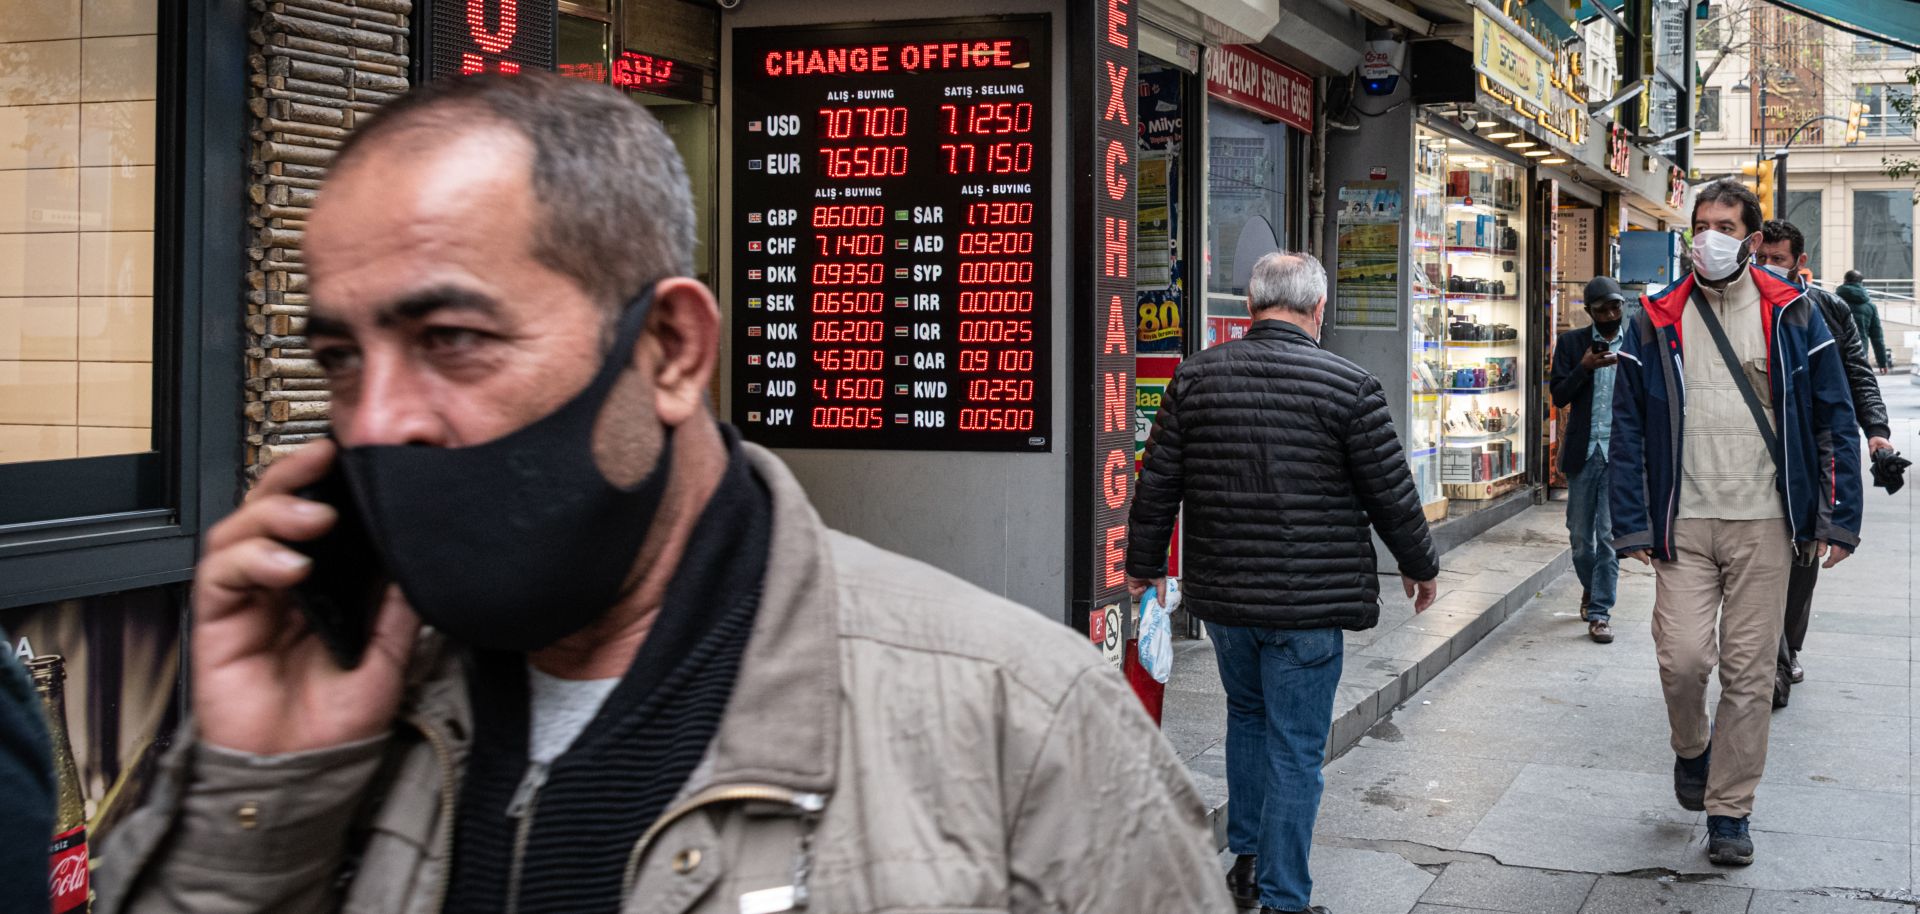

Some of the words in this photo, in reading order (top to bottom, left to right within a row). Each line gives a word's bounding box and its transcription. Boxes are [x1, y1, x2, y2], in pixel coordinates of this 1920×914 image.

[766, 47, 889, 76] CHANGE
[901, 42, 1011, 69] OFFICE
[828, 90, 849, 102] ALIŞ
[857, 89, 894, 99] BUYING
[944, 87, 974, 98] SATIŞ
[982, 85, 1024, 95] SELLING
[1205, 48, 1259, 98] BAHÇEKAPI
[1262, 66, 1289, 110] SERVET
[1291, 77, 1310, 121] GİŞESİ
[767, 115, 800, 136] USD
[820, 107, 908, 138] 7.0700
[942, 103, 1032, 134] 7.1250
[767, 154, 800, 174] EUR
[820, 147, 908, 177] 7.6500
[942, 143, 1032, 174] 7.7150
[816, 188, 836, 199] ALIŞ
[845, 188, 882, 197] BUYING
[962, 185, 983, 196] ALIŞ
[993, 184, 1031, 193] BUYING
[768, 209, 797, 226] GBP
[813, 206, 884, 228] 8.6000
[914, 207, 943, 223] SAR
[968, 203, 1032, 225] 1.7300
[767, 238, 796, 254] CHF
[816, 234, 884, 256] 7.1400
[914, 236, 943, 252] AED
[959, 232, 1032, 254] 0.9200
[767, 266, 796, 282] DKK
[813, 263, 884, 284] 0.9350
[914, 265, 942, 281] SYP
[959, 262, 1032, 284] 0.0000
[767, 295, 794, 311] SEK
[813, 292, 884, 313] 0.6500
[914, 294, 940, 310] IRR
[959, 291, 1033, 313] 0.0000
[1139, 300, 1180, 333] 80
[767, 323, 797, 339] NOK
[813, 321, 883, 342] 0.6200
[914, 323, 940, 340] IQR
[959, 320, 1032, 342] 0.0025
[767, 352, 796, 368] CAD
[814, 349, 883, 371] 4.6300
[914, 352, 945, 370] QAR
[959, 350, 1033, 372] 0.9100
[767, 380, 796, 397] AUD
[814, 378, 883, 400] 4.1500
[914, 381, 947, 398] KWD
[969, 379, 1033, 401] 1.0250
[767, 409, 794, 425] JPY
[813, 407, 882, 428] 0.0605
[914, 411, 945, 427] RUB
[959, 409, 1033, 430] 0.0500
